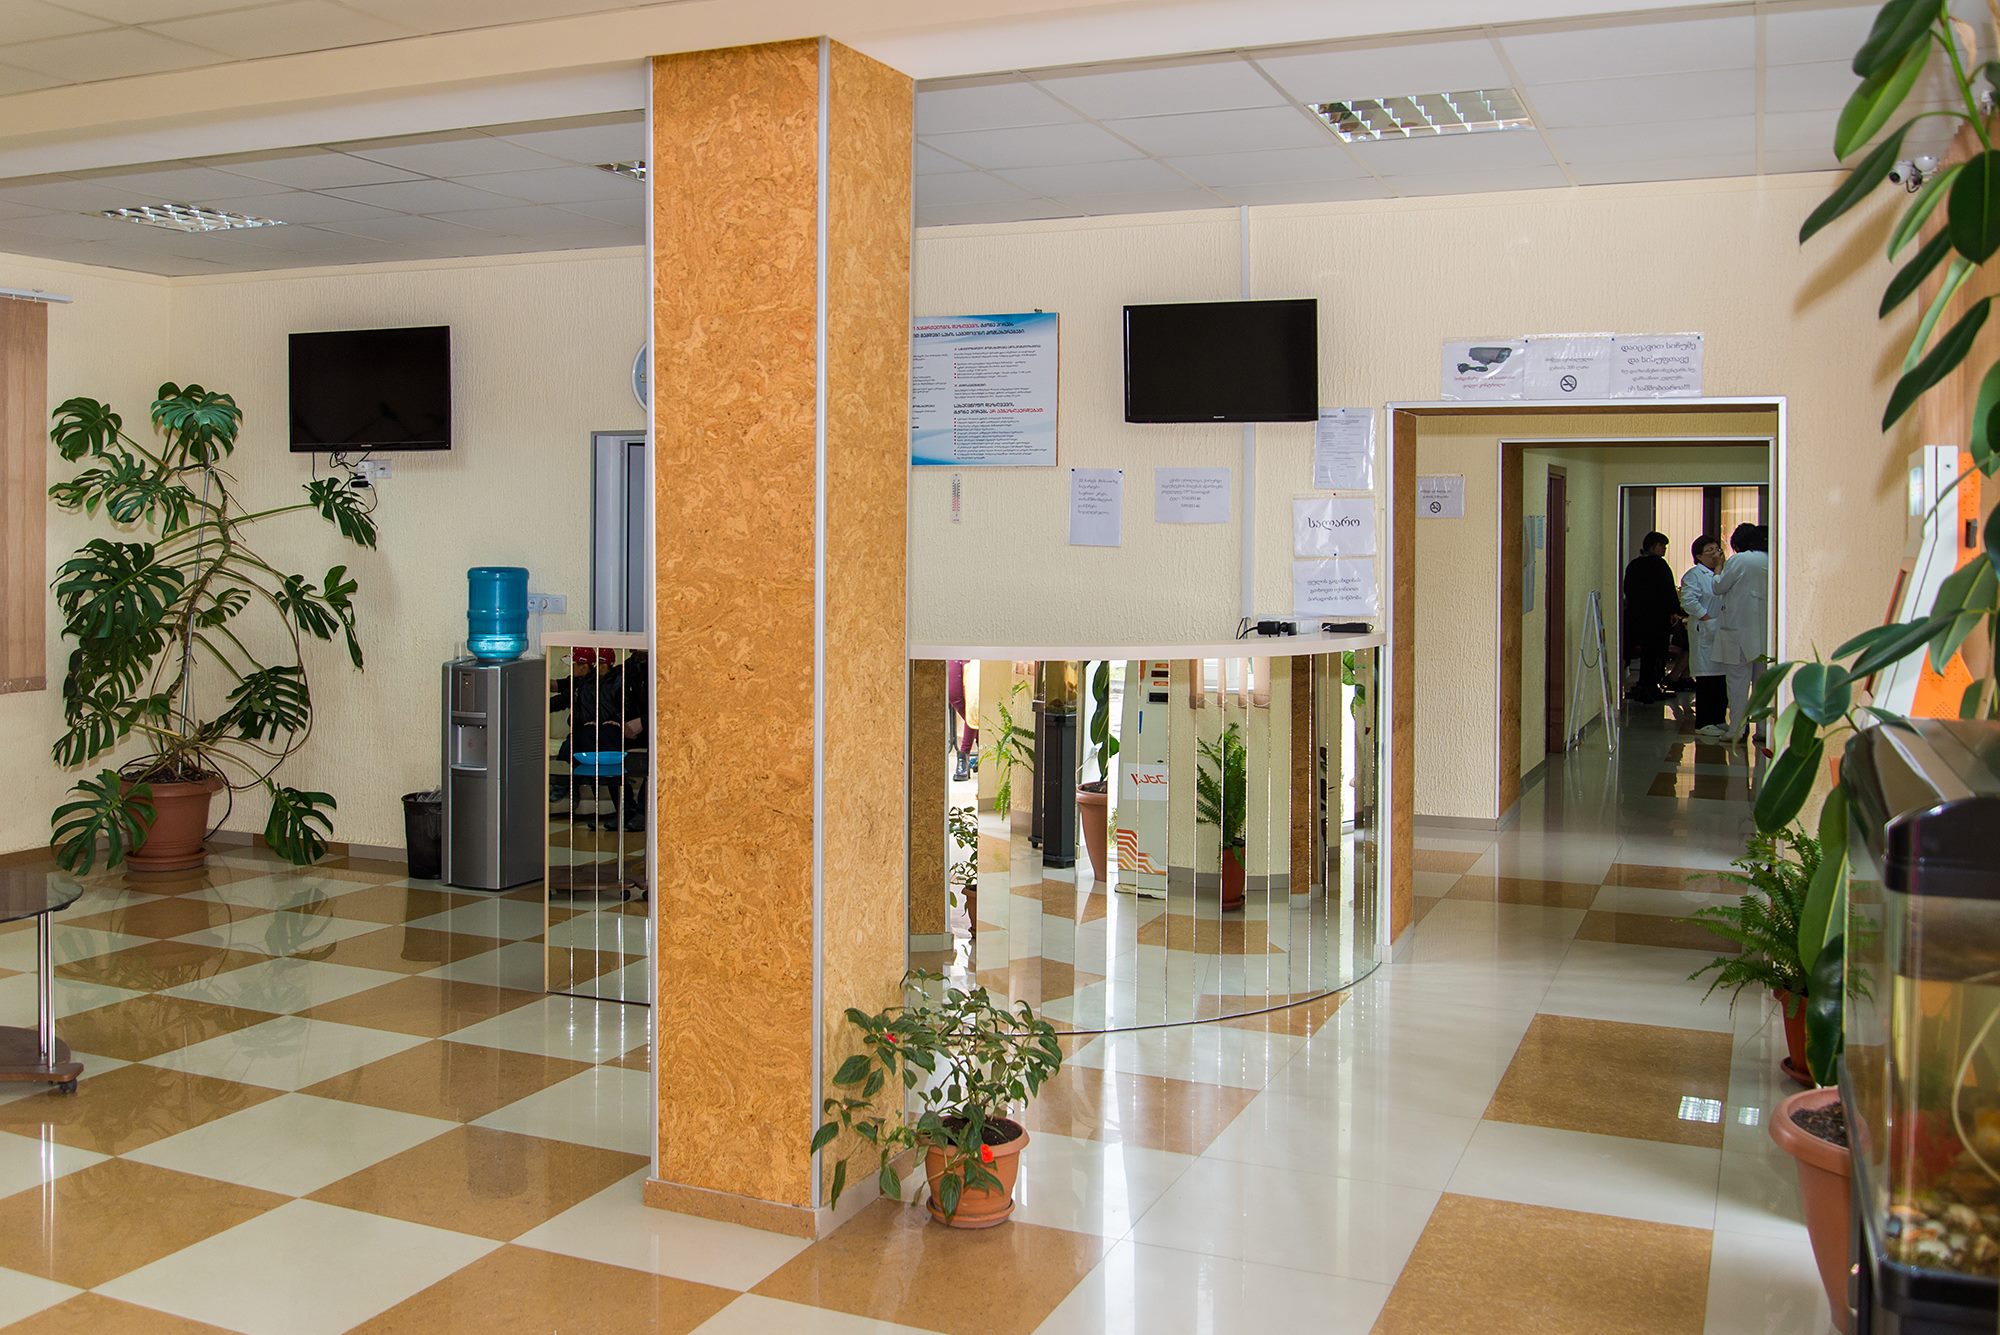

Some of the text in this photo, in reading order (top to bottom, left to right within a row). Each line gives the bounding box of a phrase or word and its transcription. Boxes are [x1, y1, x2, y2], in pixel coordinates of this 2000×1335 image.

[1621, 341, 1696, 353] დაიცავით სიჩუმე
[1627, 355, 1689, 365] და სისუფთავე
[1308, 516, 1360, 530] სალარო
